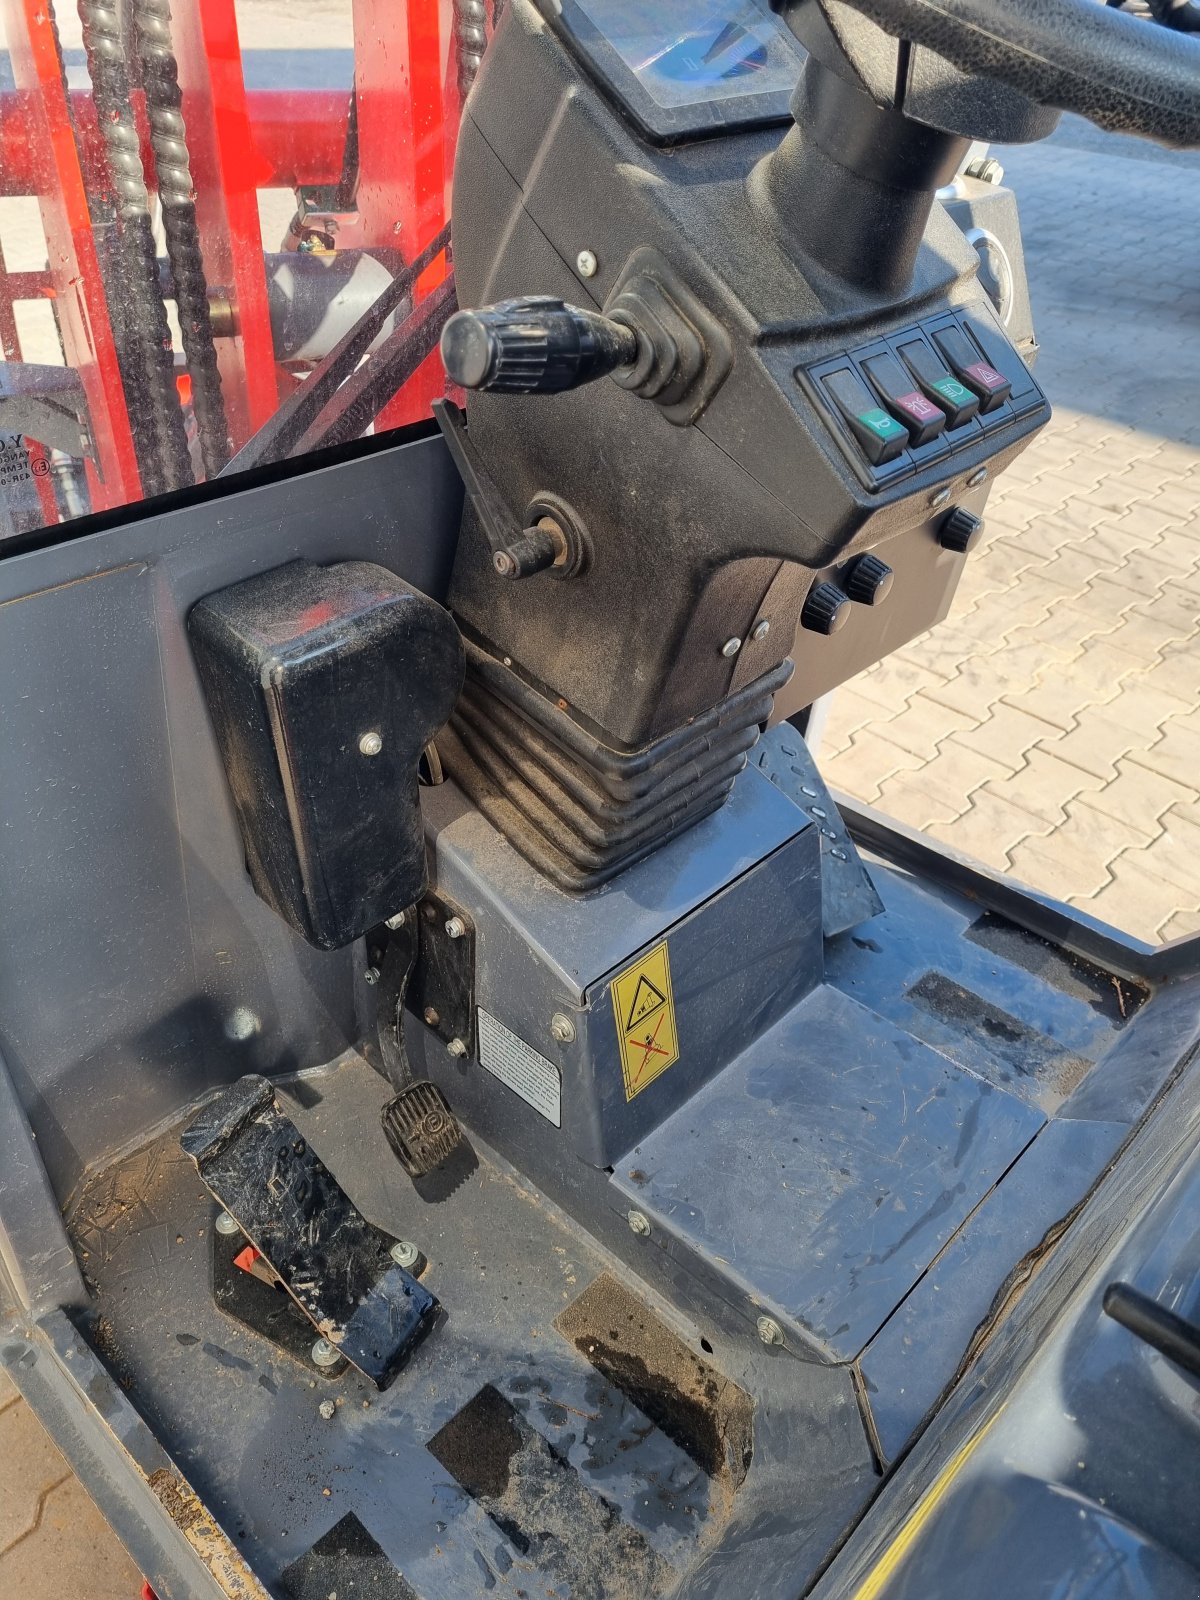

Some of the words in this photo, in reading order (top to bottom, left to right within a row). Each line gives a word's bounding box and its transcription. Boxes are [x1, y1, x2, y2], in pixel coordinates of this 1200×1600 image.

[482, 1011, 505, 1035] OPERATION
[506, 1030, 512, 1038] OF
[513, 1035, 522, 1047] THE
[522, 1043, 541, 1062] PARKING
[542, 1058, 557, 1075] BRAKE
